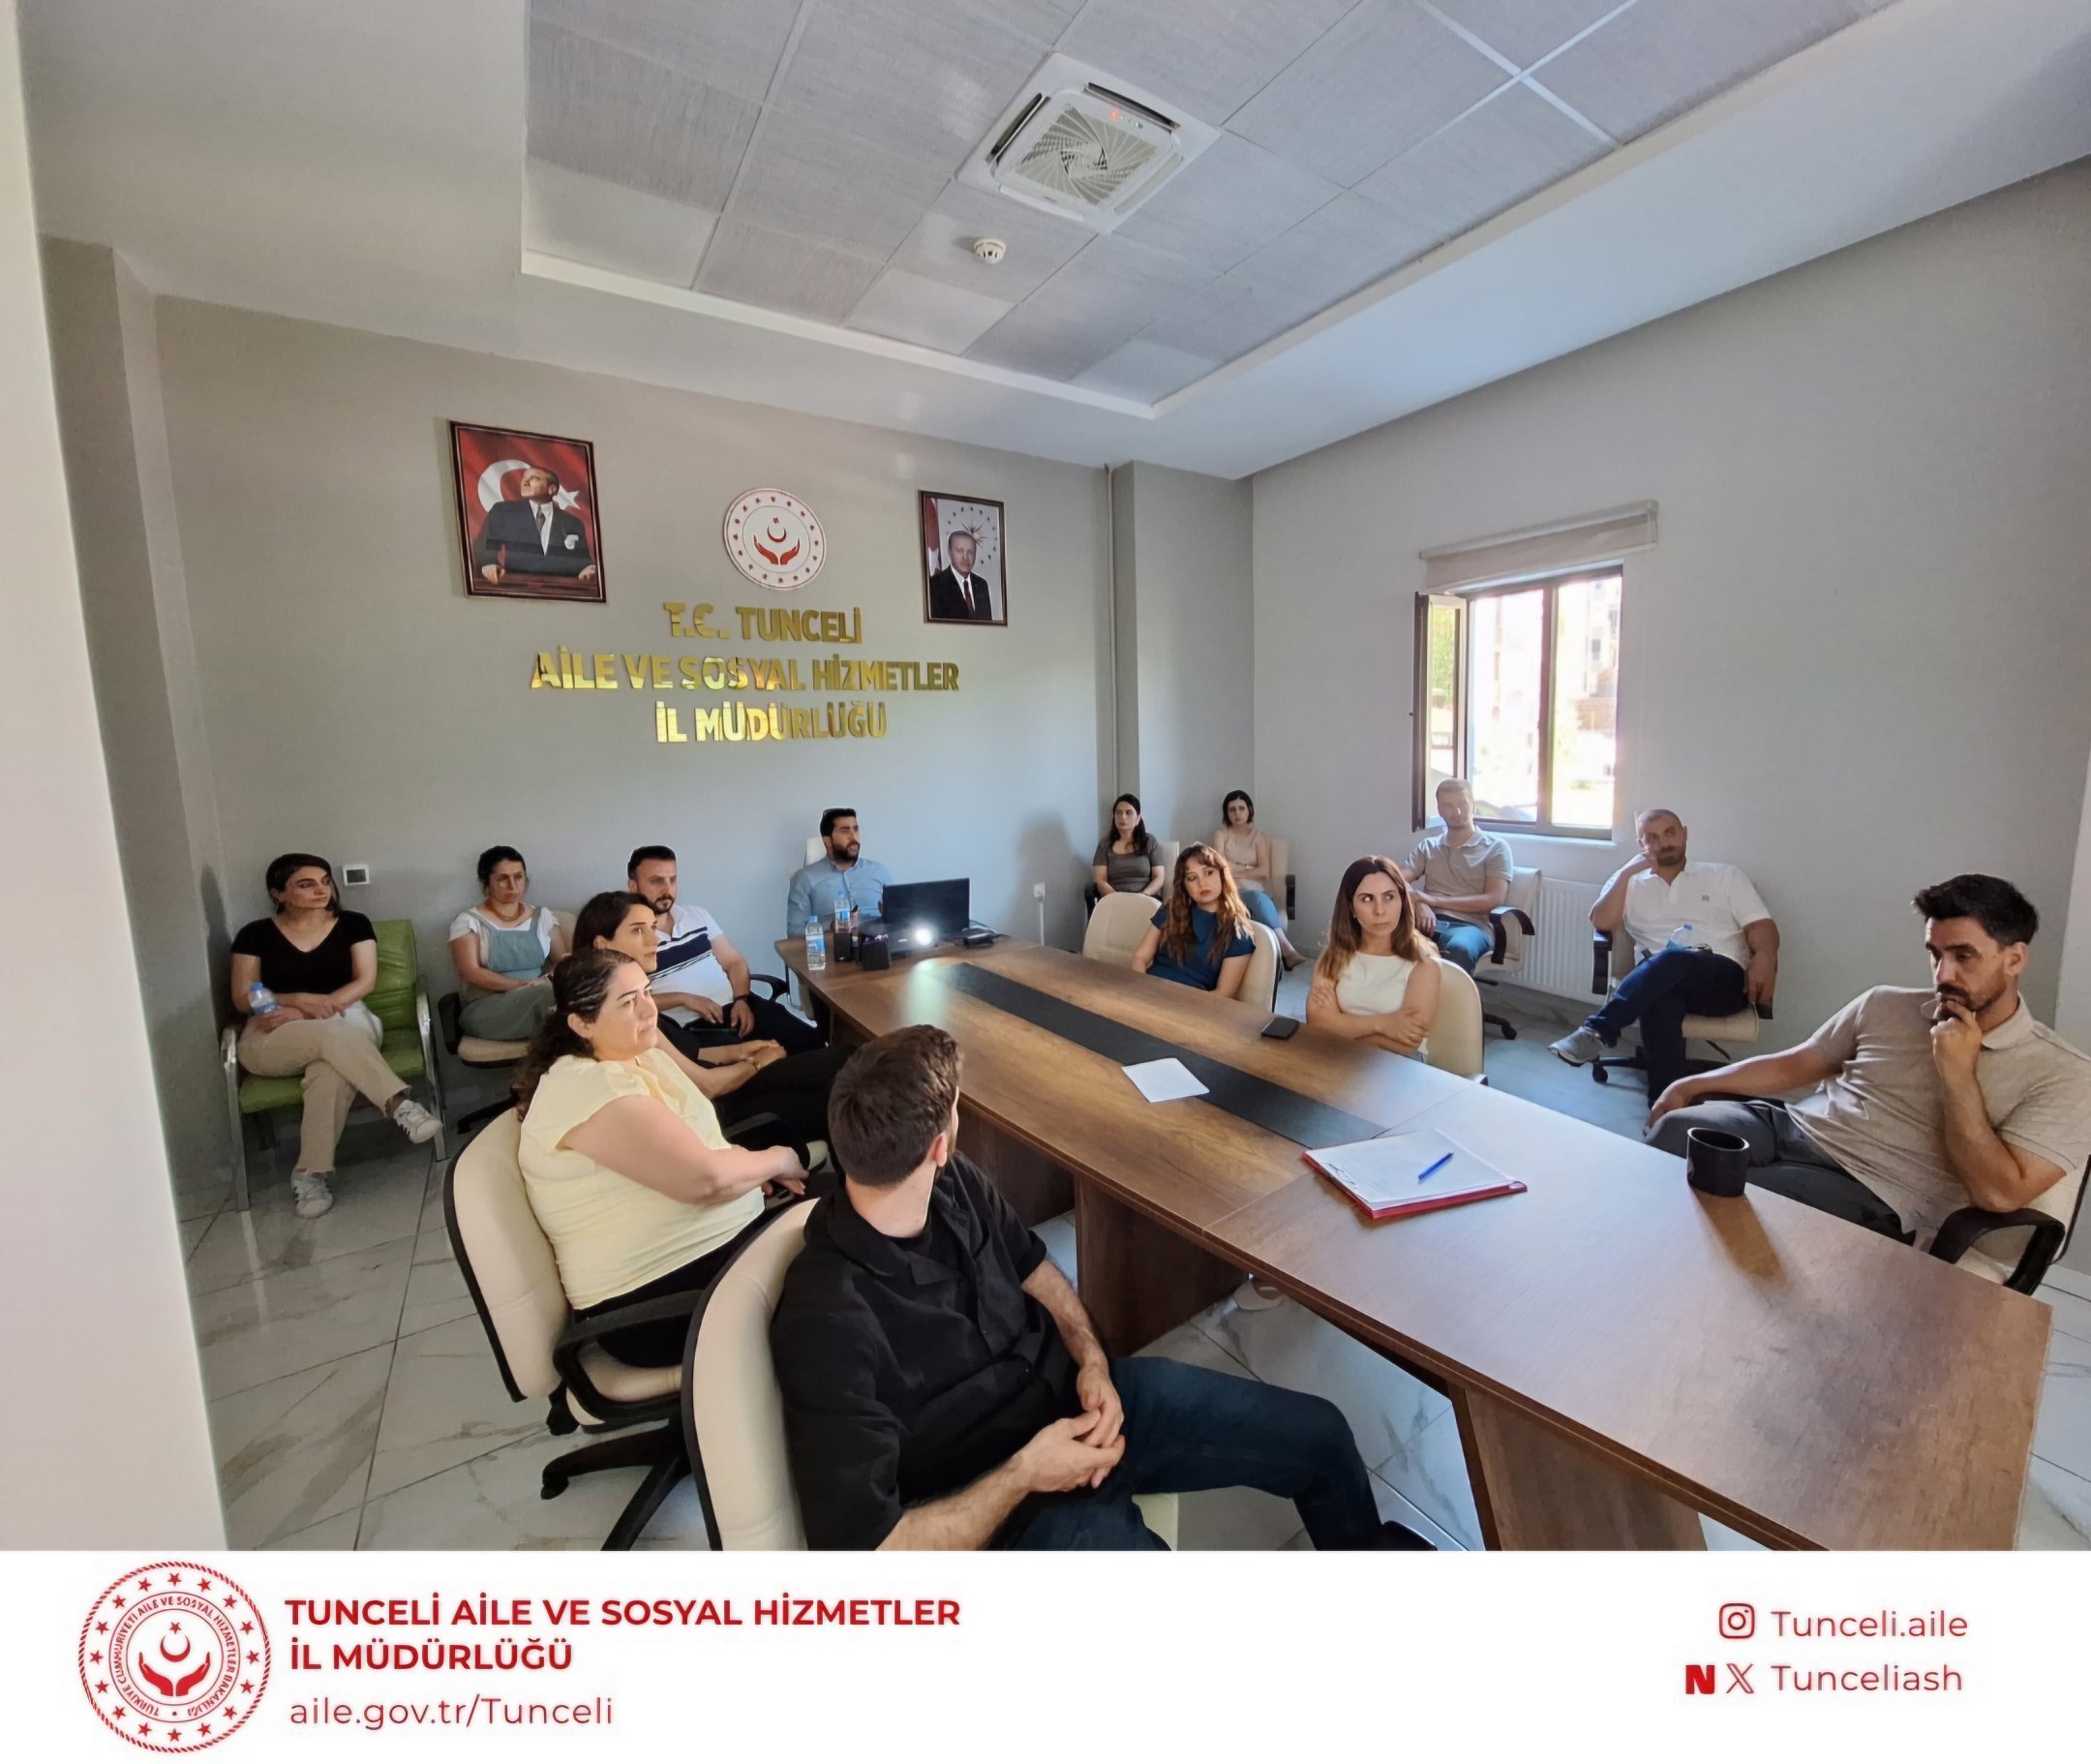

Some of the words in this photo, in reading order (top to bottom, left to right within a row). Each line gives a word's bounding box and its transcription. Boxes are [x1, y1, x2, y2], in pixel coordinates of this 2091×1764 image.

[663, 601, 730, 639] T.C.
[736, 605, 863, 644] TUNCELİ
[530, 645, 619, 690] AİLE
[622, 653, 674, 690] VE
[679, 654, 805, 691] SOSYAL
[812, 654, 960, 692] HİZMETLER
[655, 700, 687, 744] İL
[694, 699, 888, 743] MÜDÜRLÜĞÜ
